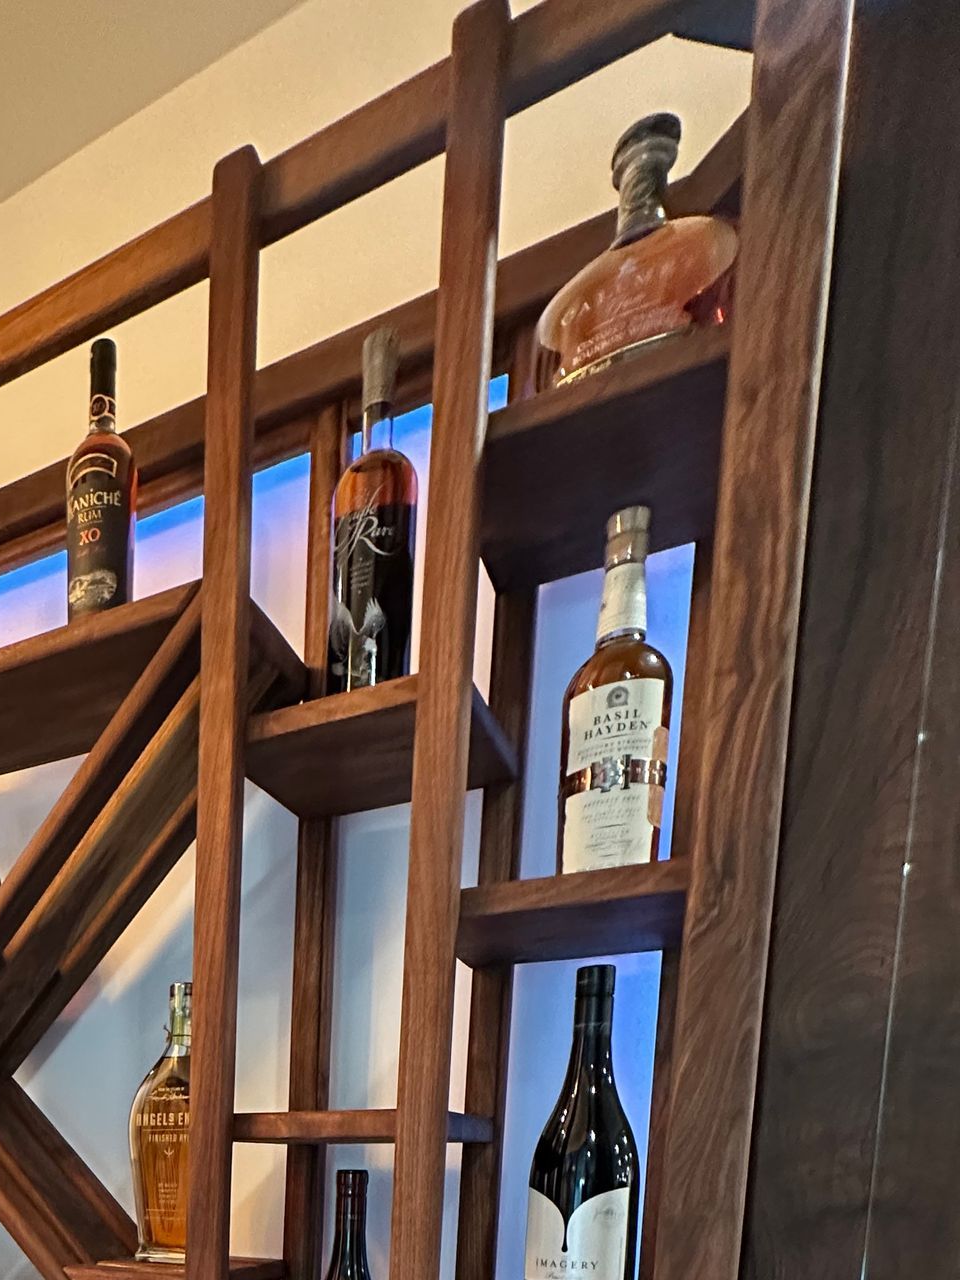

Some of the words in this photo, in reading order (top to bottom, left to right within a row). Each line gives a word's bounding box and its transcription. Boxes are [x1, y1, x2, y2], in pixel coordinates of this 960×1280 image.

[78, 509, 102, 525] RUM
[79, 527, 101, 546] XO
[593, 708, 641, 727] BASIL
[583, 720, 649, 741] HAYDEN
[148, 1133, 177, 1144] FINISHED
[535, 1257, 600, 1271] IMAGERY
